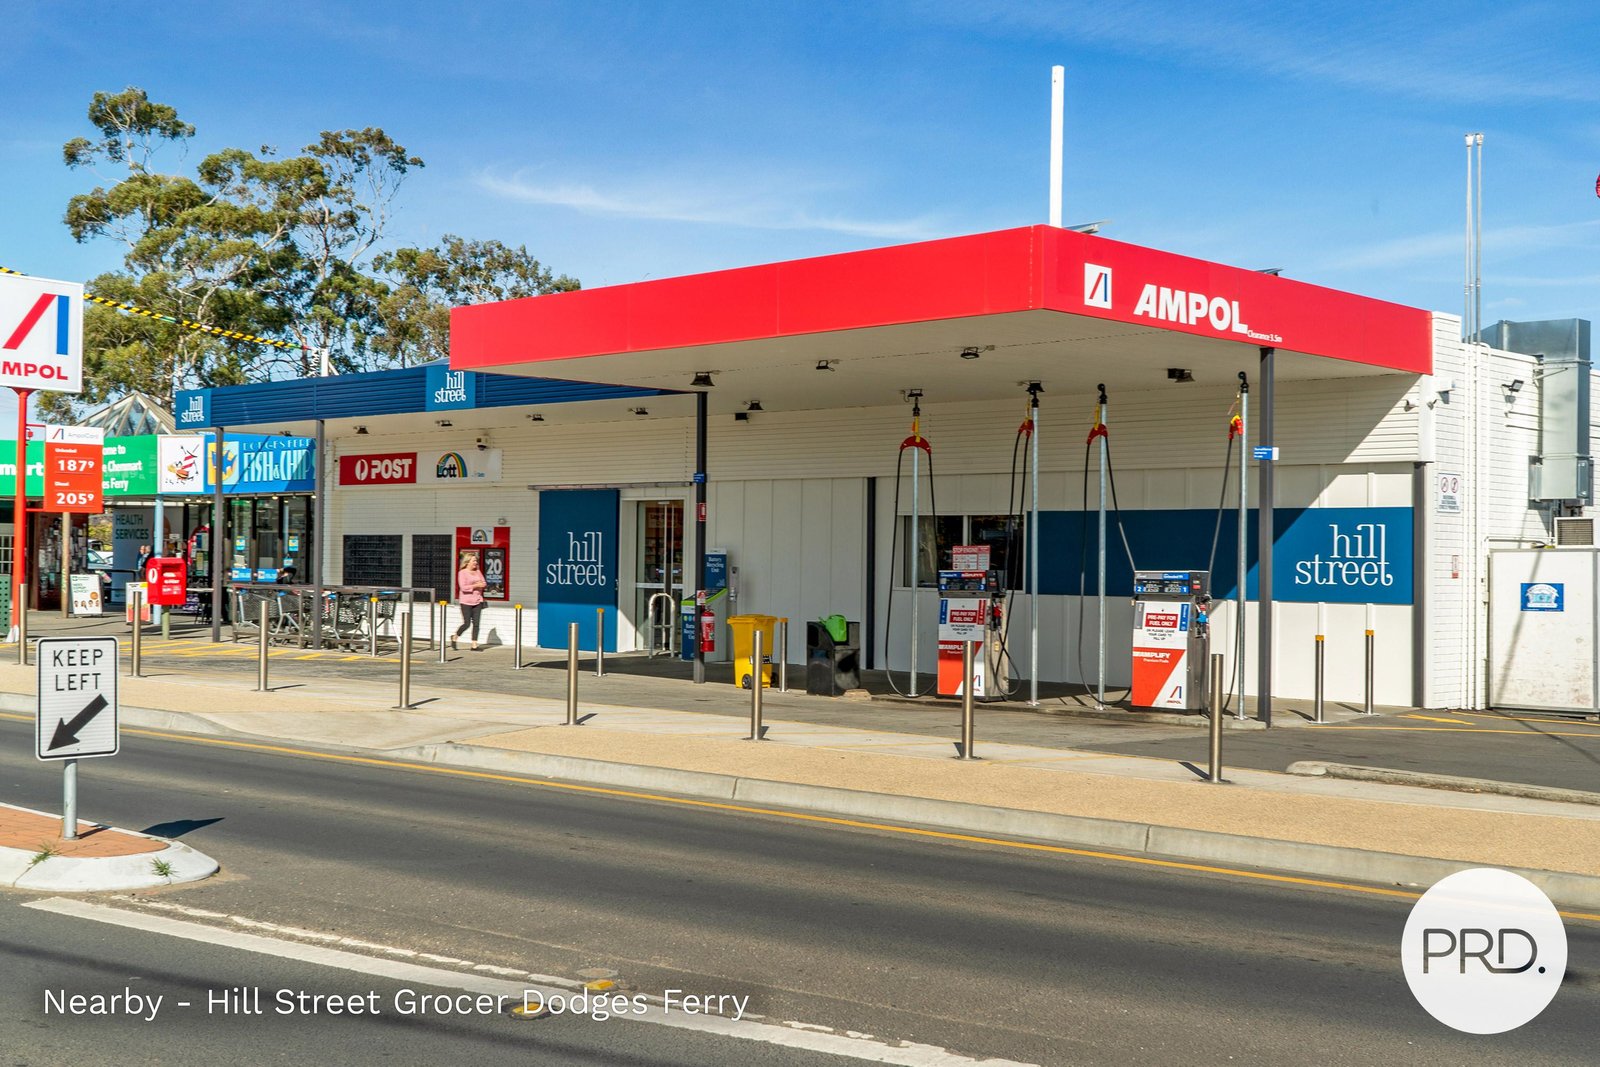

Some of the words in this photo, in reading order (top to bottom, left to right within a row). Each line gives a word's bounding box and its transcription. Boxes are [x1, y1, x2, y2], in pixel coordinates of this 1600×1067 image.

[1133, 283, 1248, 334] AMPOL
[2, 361, 68, 380] MPOL
[445, 371, 465, 389] hill
[189, 396, 204, 411] hill
[434, 388, 467, 403] street
[181, 409, 205, 423] street
[243, 440, 286, 451] DODGES
[243, 451, 274, 482] FISH
[273, 464, 280, 479] &
[371, 458, 413, 480] POST
[110, 477, 129, 492] Ferry
[115, 514, 144, 525] HEALTH
[115, 528, 149, 540] SERVICES
[1328, 524, 1386, 559] hill
[567, 532, 602, 562] hill
[546, 558, 606, 586] street
[1295, 554, 1394, 586] street
[53, 648, 103, 667] KEEP
[55, 673, 101, 691] LEFT
